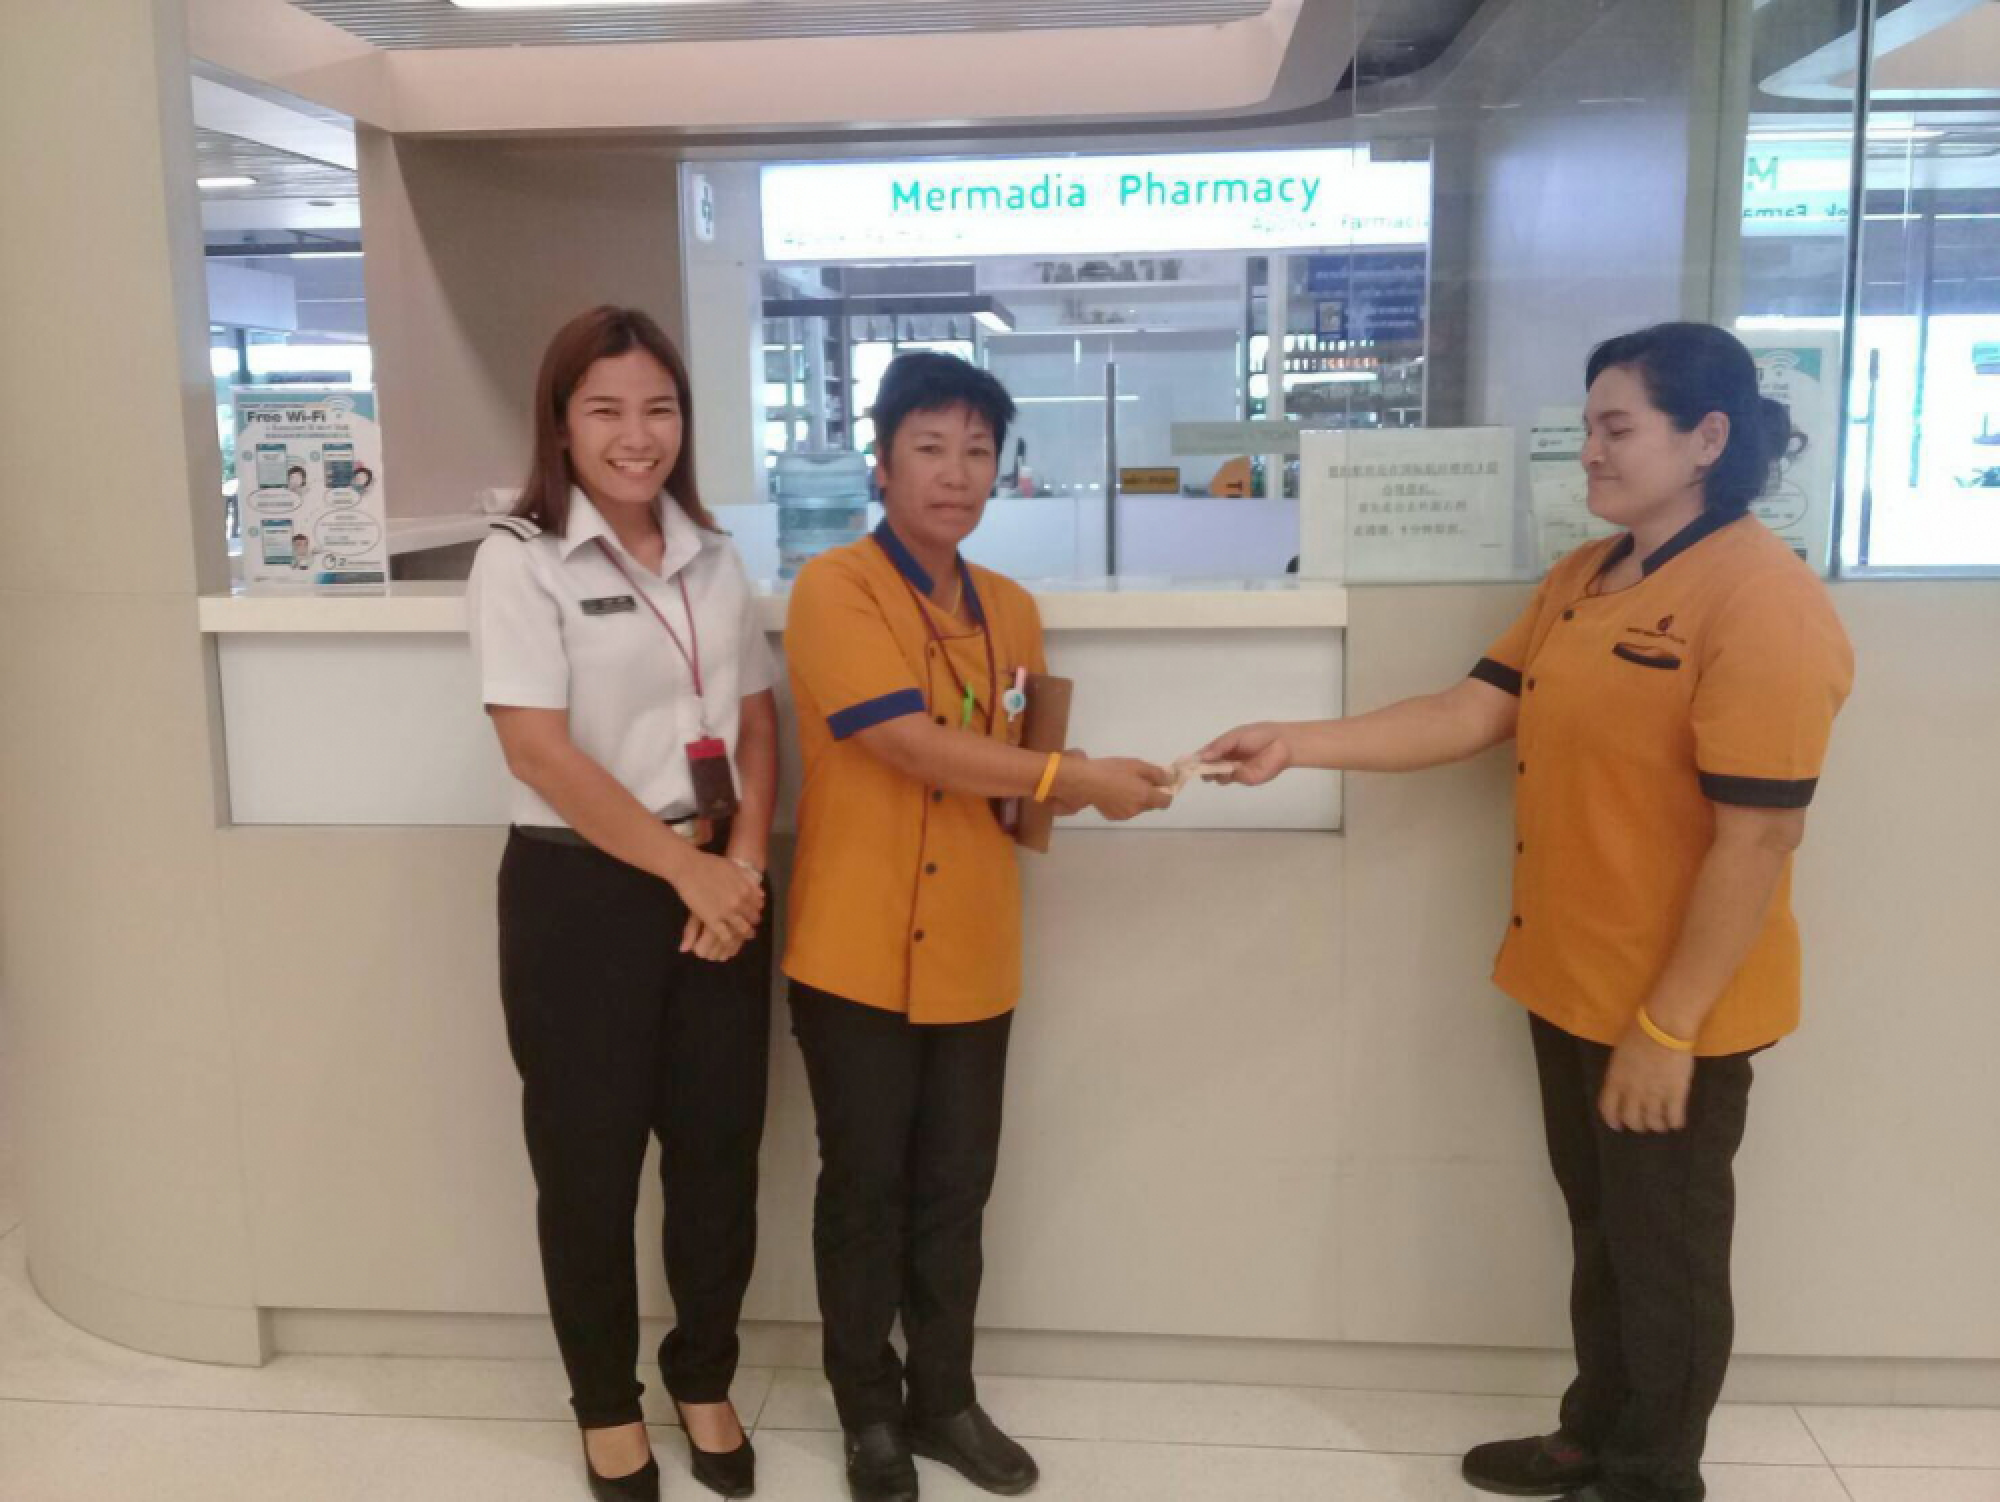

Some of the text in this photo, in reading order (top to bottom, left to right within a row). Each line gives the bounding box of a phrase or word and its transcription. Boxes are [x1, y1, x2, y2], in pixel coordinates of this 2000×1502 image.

[891, 172, 1320, 212] Mermadia Pharmacy
[246, 409, 327, 423] Free Wi-Fi
